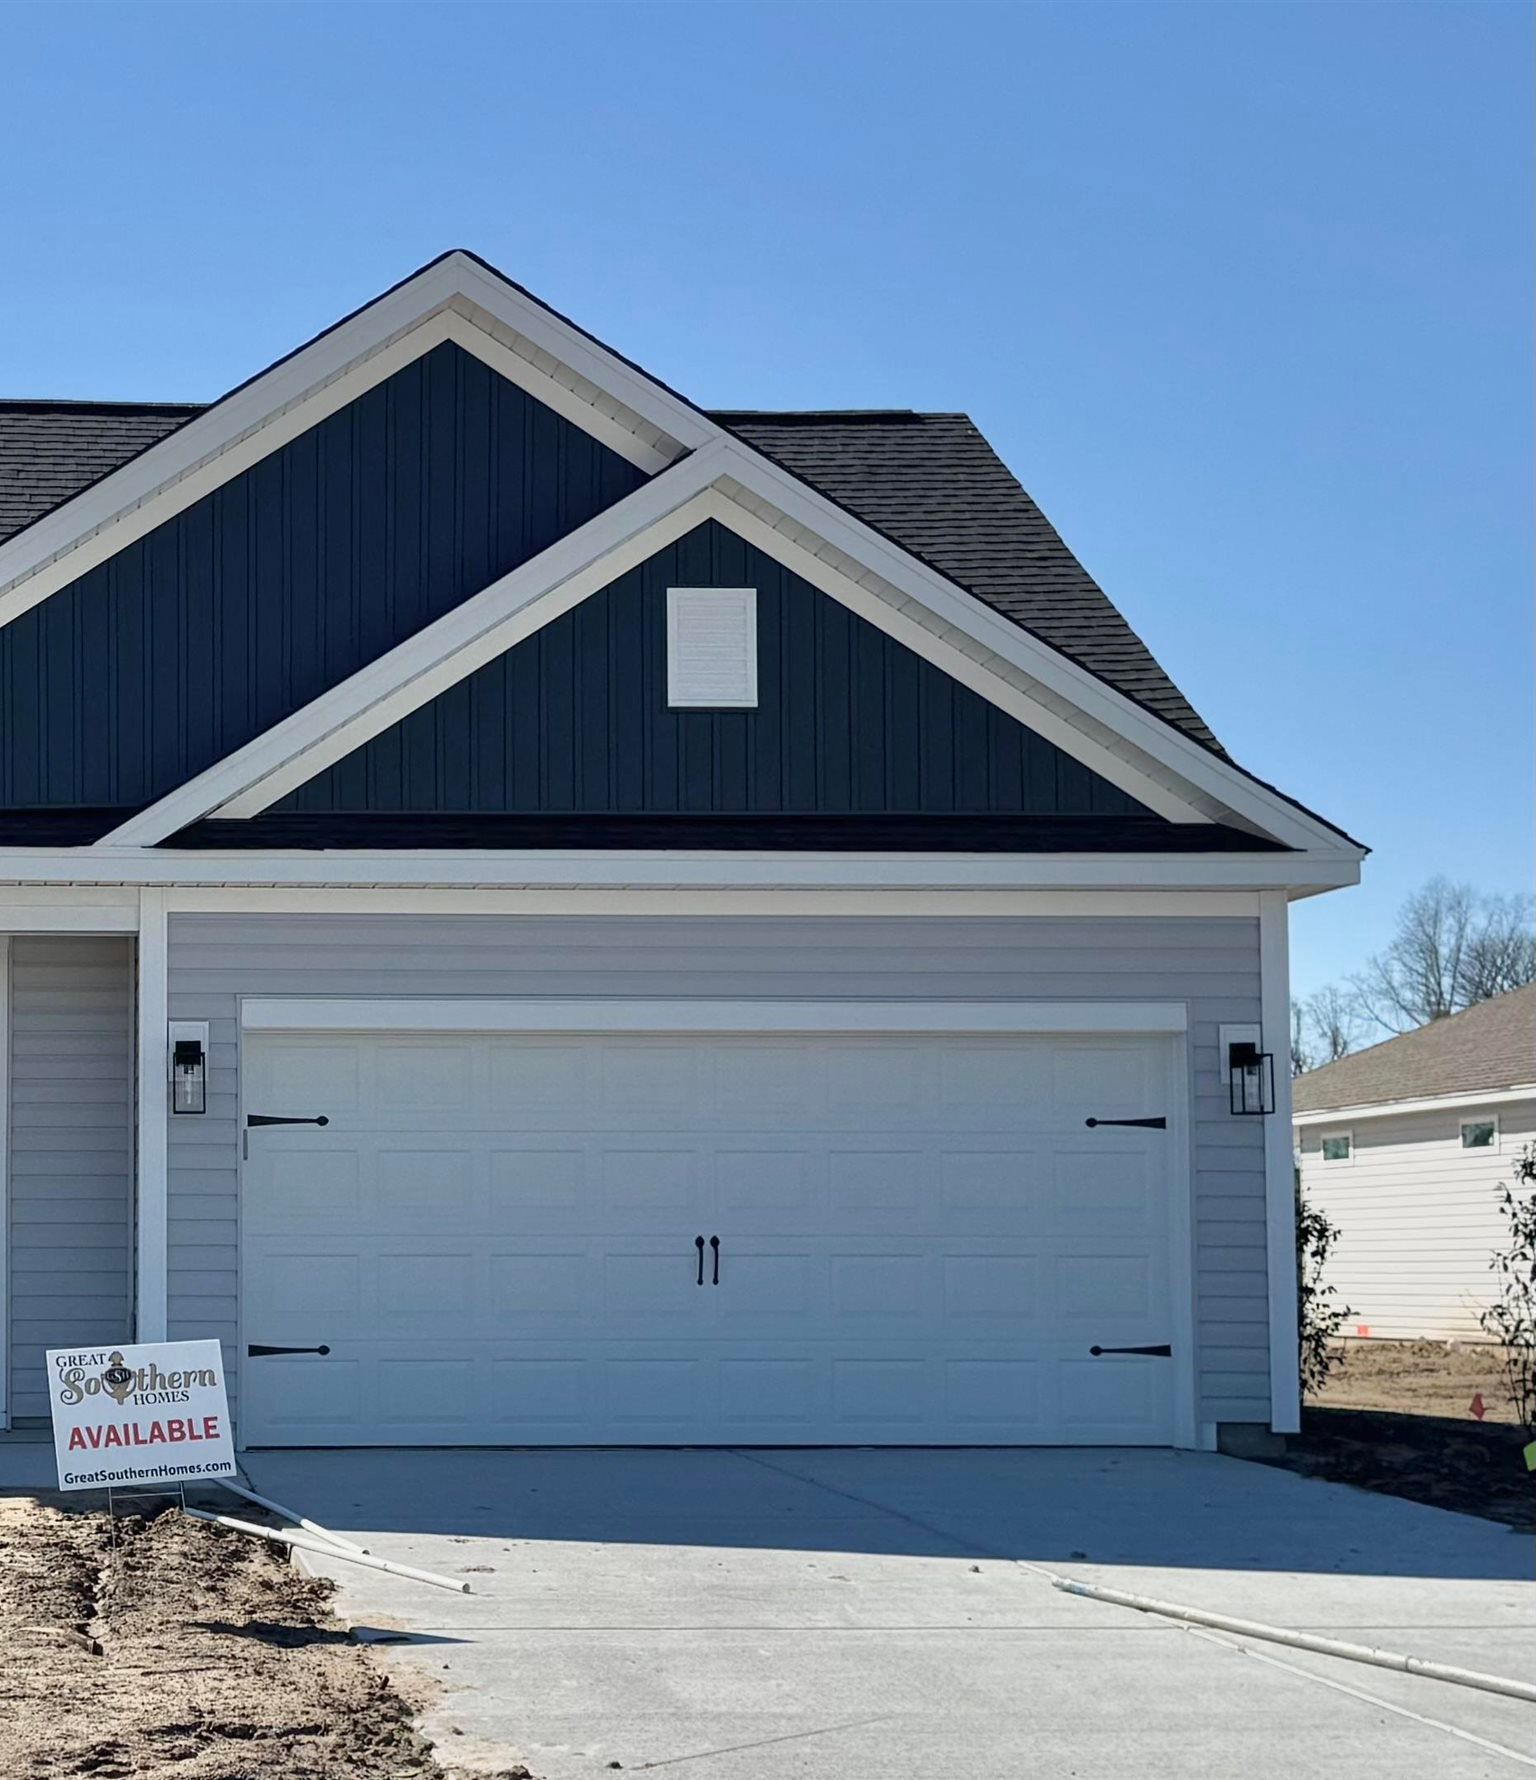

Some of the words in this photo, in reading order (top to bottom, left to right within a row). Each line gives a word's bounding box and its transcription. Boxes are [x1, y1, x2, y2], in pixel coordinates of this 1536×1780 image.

[55, 1353, 106, 1368] GREAT
[59, 1363, 217, 1406] Southern
[133, 1390, 190, 1406] HOMES
[68, 1416, 221, 1451] AVAILABLE
[64, 1461, 232, 1485] GreatSouthernHomes.com
